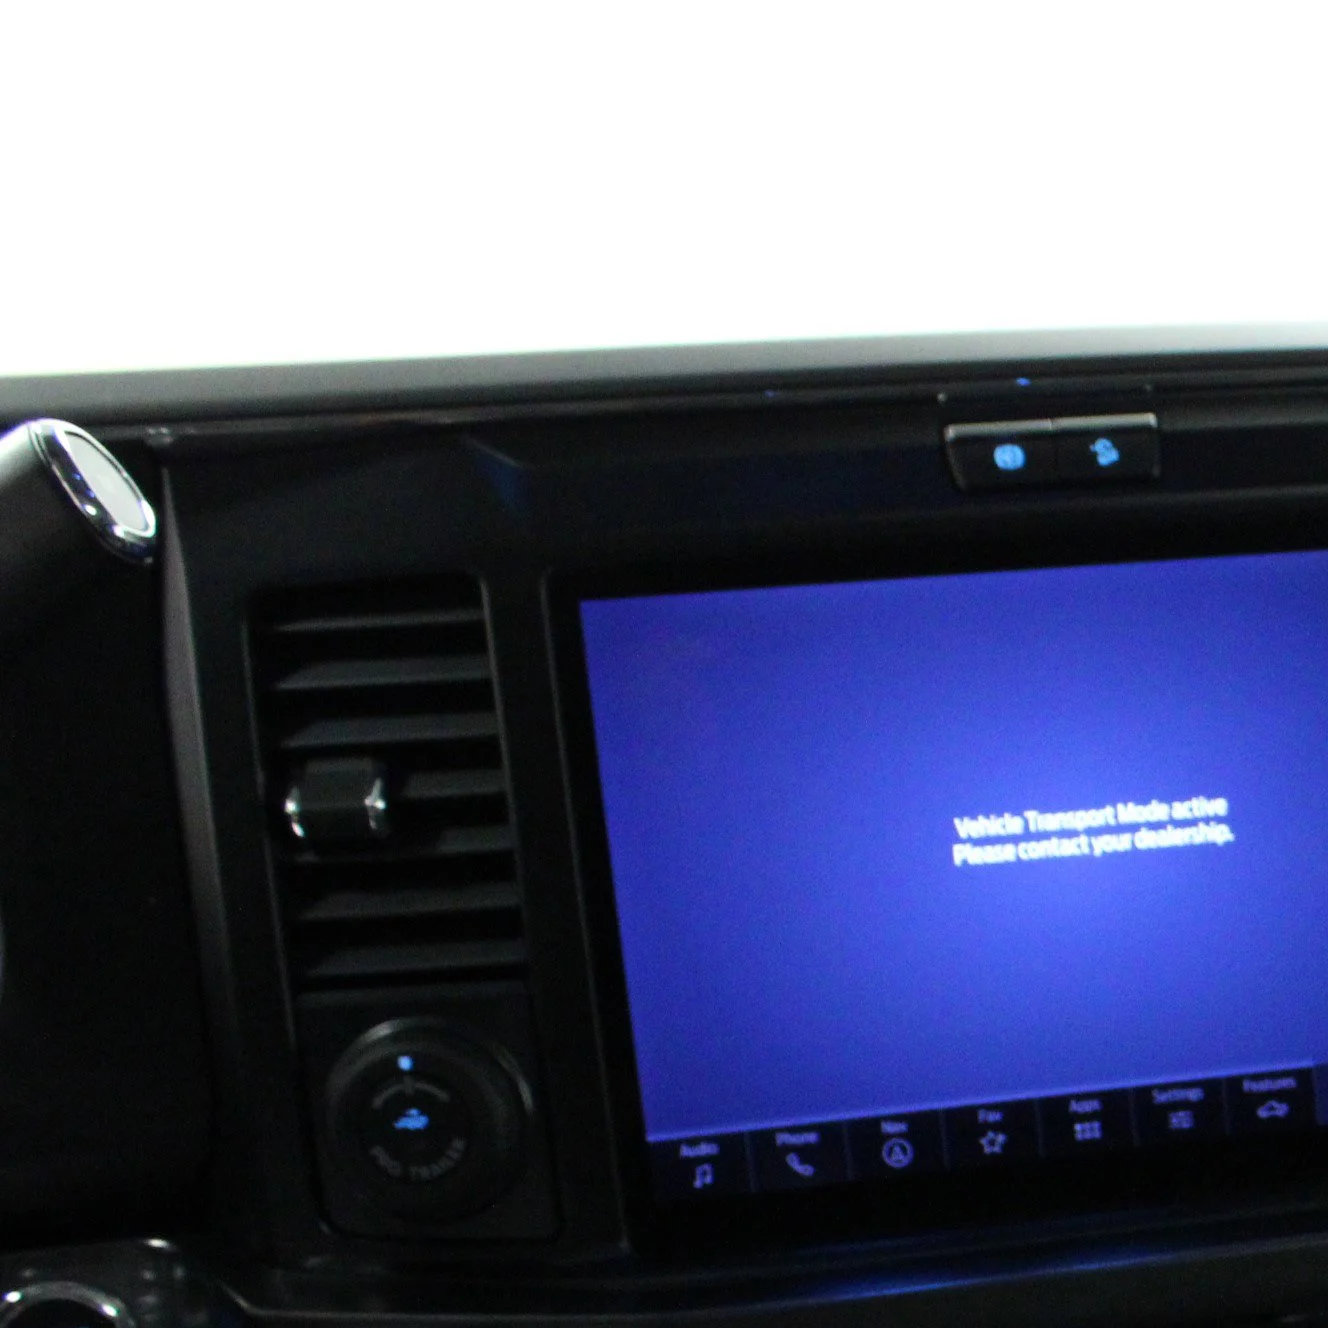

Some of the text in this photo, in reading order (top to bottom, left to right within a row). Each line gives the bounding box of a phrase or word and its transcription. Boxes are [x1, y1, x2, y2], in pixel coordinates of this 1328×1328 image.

[954, 796, 1228, 839] Vehicle Transport Mode active
[953, 838, 1016, 866] Please
[1018, 831, 1090, 860] contact
[1091, 831, 1133, 856] your
